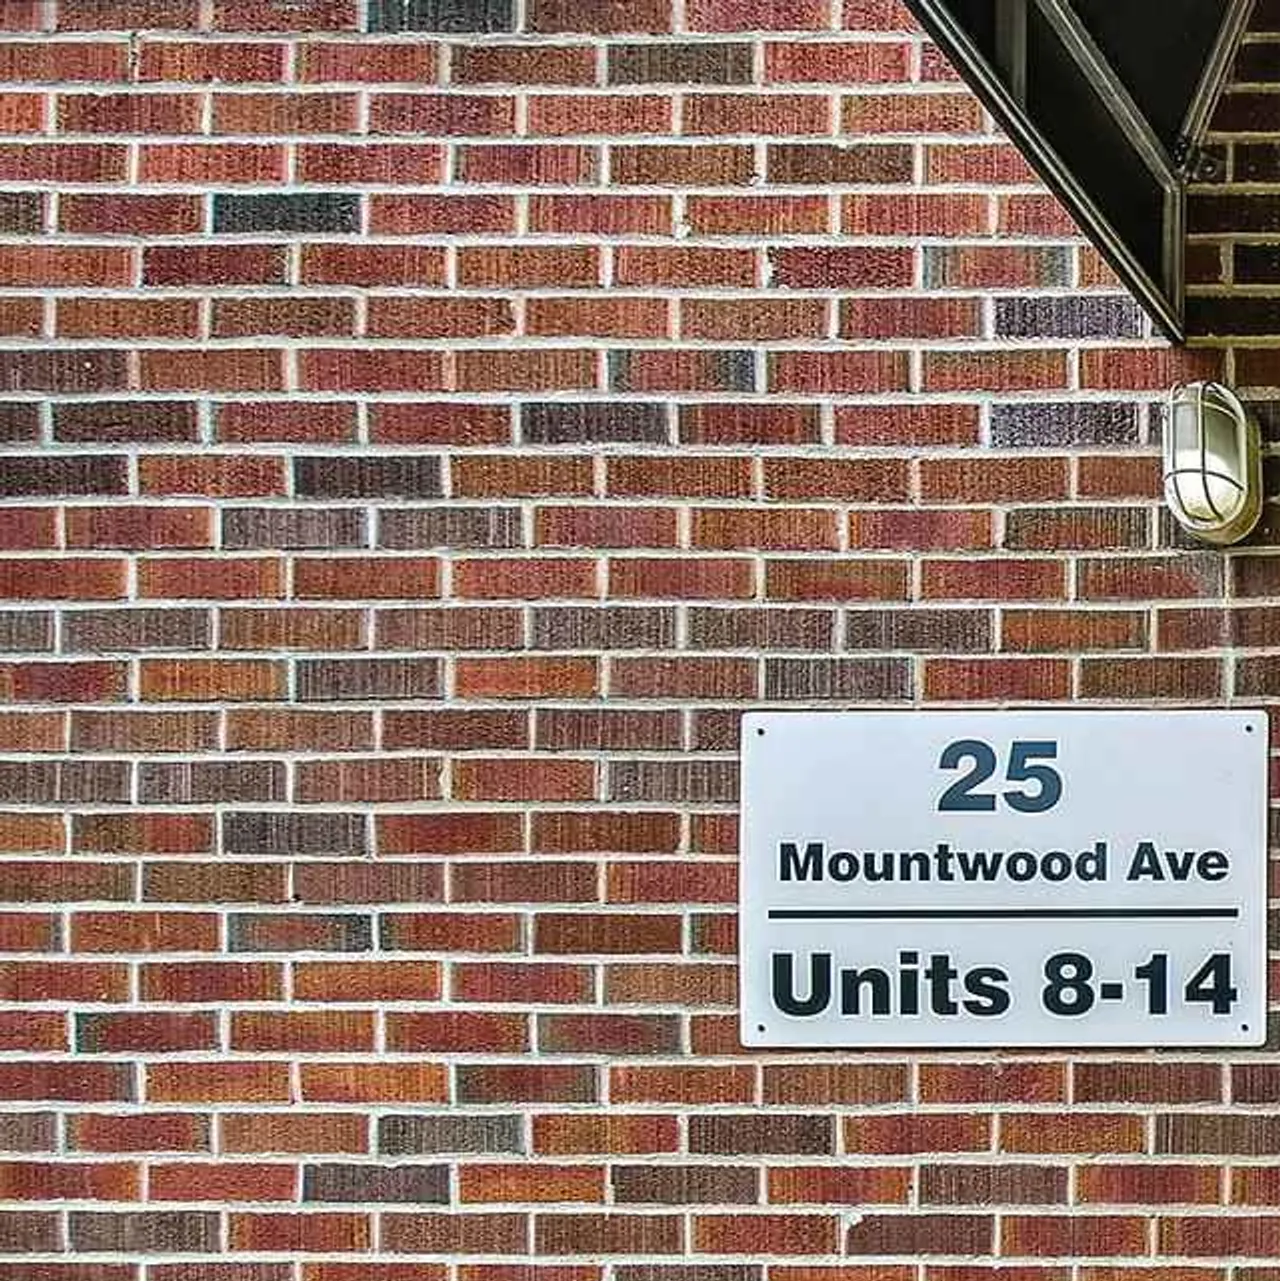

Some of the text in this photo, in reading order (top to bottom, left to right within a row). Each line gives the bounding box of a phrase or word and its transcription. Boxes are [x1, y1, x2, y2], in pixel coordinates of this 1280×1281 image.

[937, 739, 1063, 813] 25
[779, 841, 1229, 882] Mountwood Ave
[772, 951, 1238, 1017] Units 8-14
